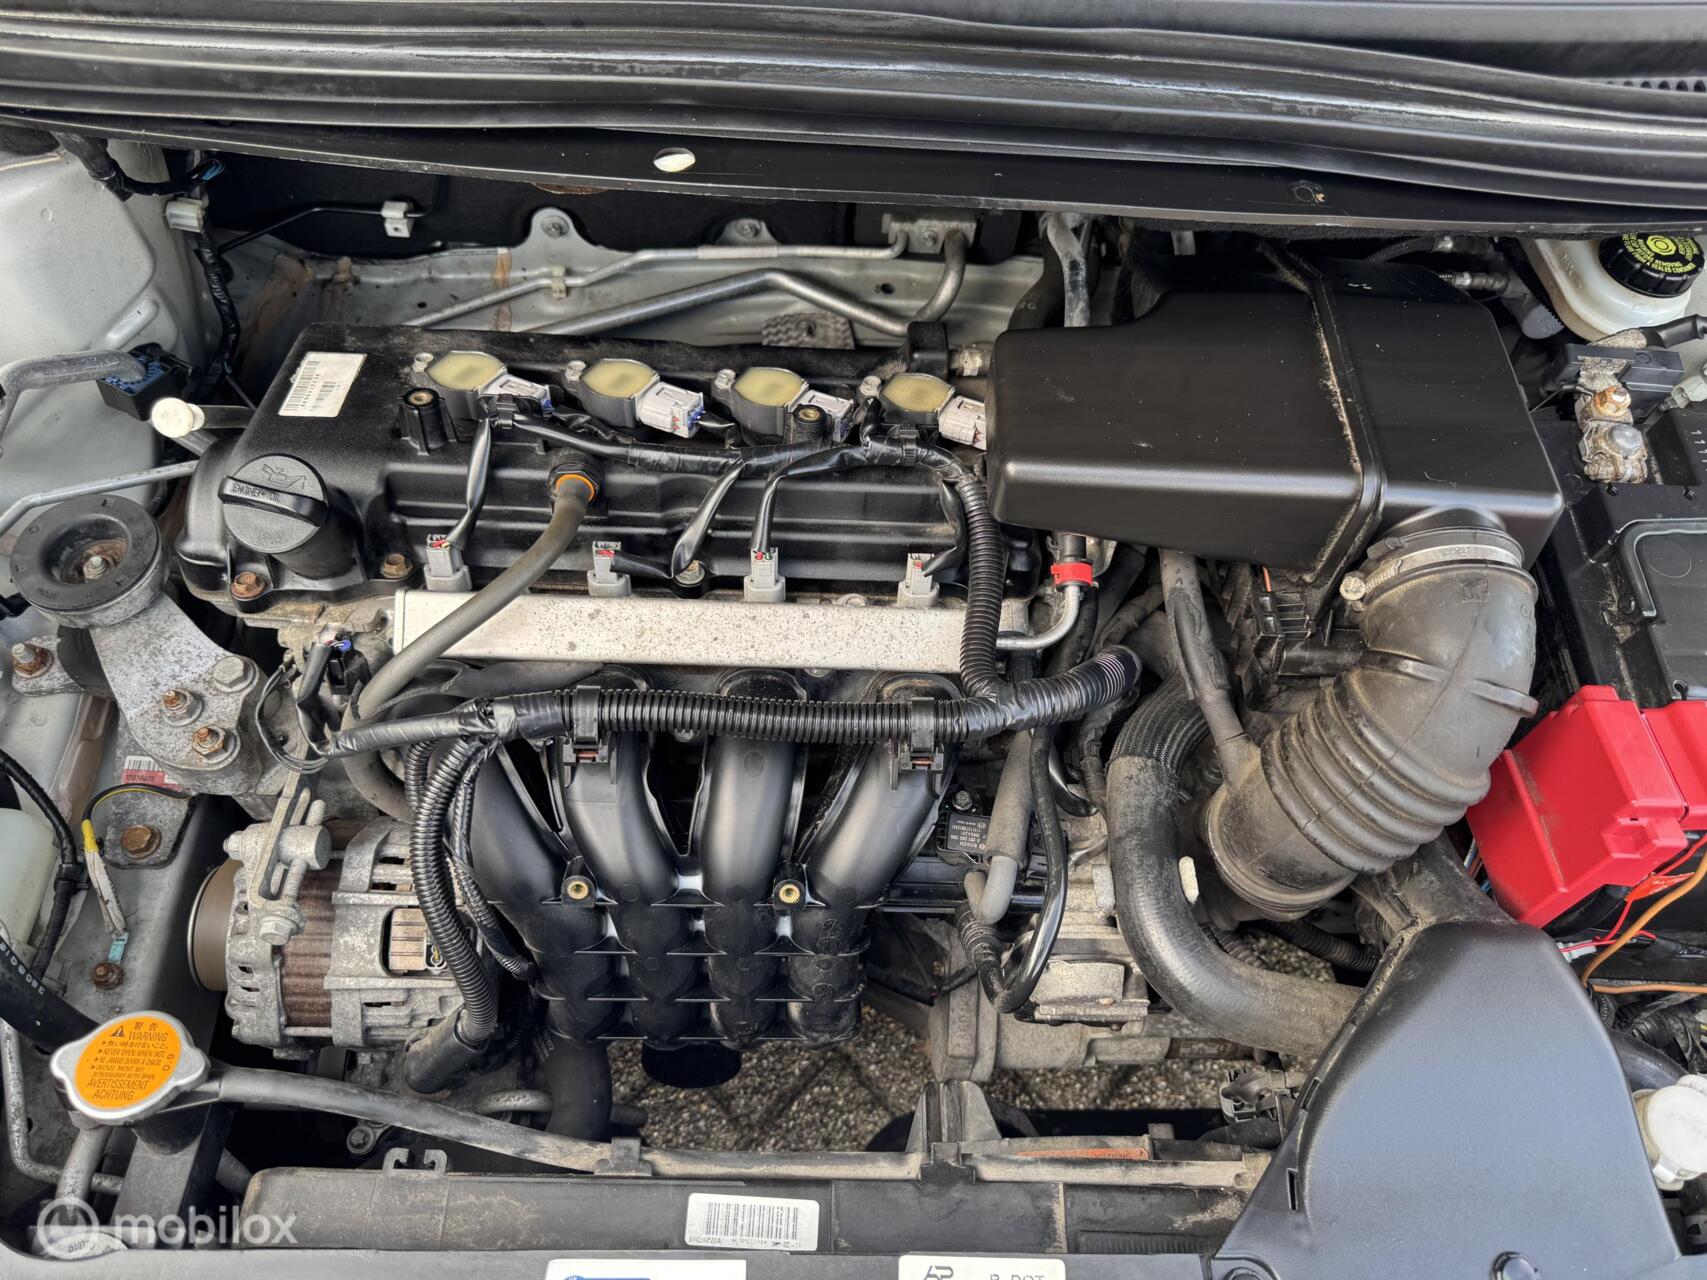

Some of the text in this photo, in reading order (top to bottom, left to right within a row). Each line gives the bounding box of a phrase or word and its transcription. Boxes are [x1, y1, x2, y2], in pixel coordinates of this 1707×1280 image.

[129, 1031, 168, 1042] WARNING
[86, 1078, 150, 1091] AVERTISSEMENT
[92, 1088, 135, 1101] ACHTUNG
